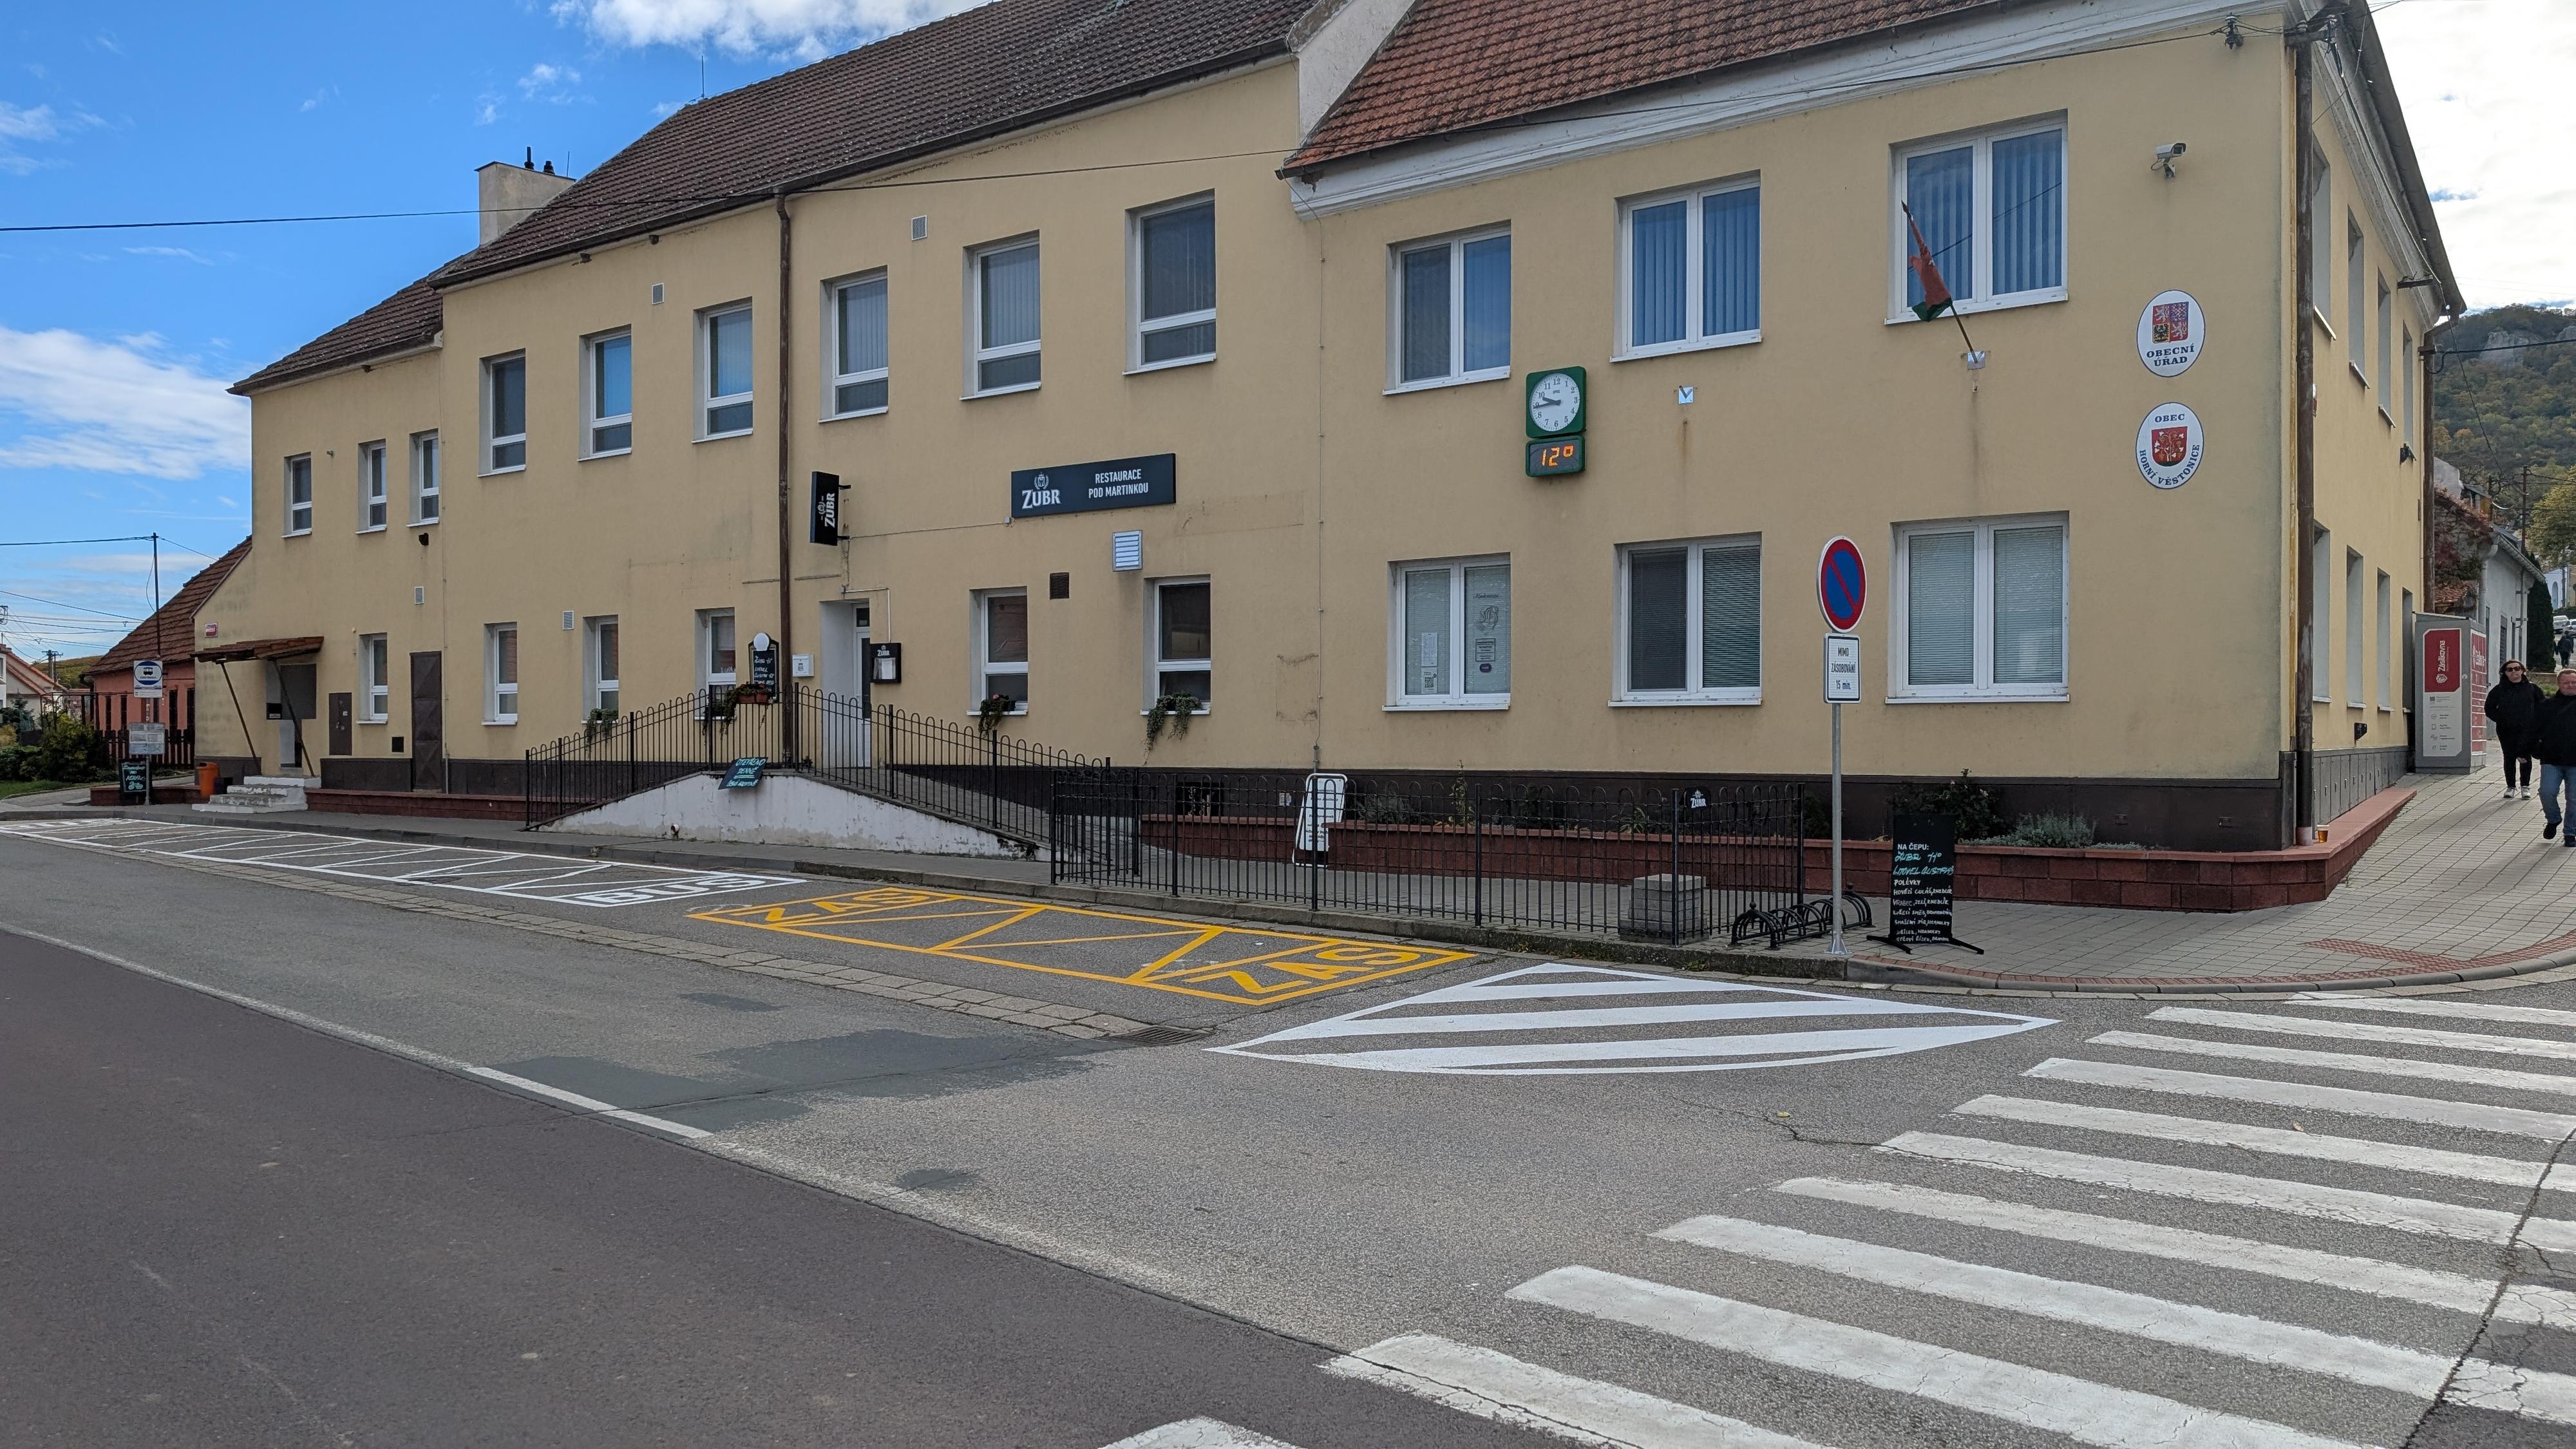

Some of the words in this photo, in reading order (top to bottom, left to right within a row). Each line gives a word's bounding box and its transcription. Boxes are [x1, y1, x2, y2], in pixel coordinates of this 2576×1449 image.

[2146, 343, 2195, 358] OBECNÍ
[2154, 356, 2188, 366] ÚŘAD
[2155, 413, 2185, 422] OBEC
[2139, 450, 2158, 479] HORNÍ
[2158, 444, 2200, 485] VĚSTONICE
[1095, 469, 1142, 484] RESTAURACE
[1088, 487, 1103, 498] POD
[1105, 482, 1149, 497] MARTINKOU
[1021, 489, 1061, 509] ZUBR
[824, 493, 835, 528] ZUBR
[1837, 647, 1849, 657] MIMO
[2438, 640, 2446, 672] Zásilkovna
[1831, 661, 1856, 674] ZÁSOBOVÁNÍ
[1836, 679, 1841, 690] 15
[1842, 680, 1852, 690] min.
[1690, 798, 1707, 808] ZUBR
[574, 878, 766, 903] BUS
[728, 893, 931, 922] ZAS
[1182, 947, 1420, 994] ZAS
